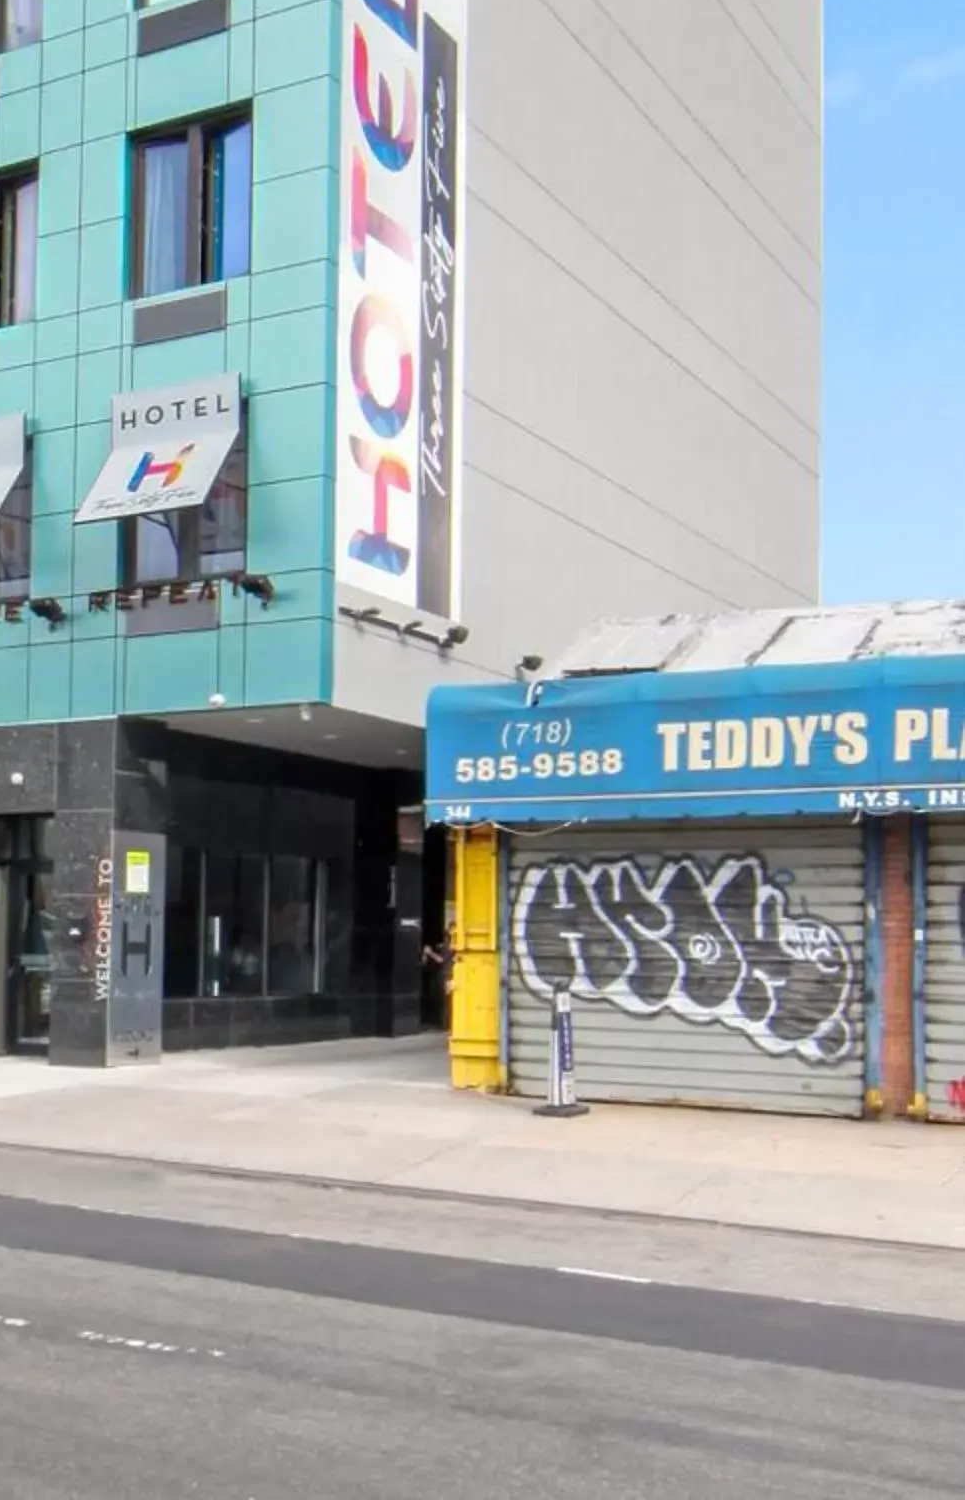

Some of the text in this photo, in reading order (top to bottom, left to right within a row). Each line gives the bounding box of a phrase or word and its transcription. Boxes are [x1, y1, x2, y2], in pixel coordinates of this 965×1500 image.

[420, 76, 454, 497] Three Sixty Five
[119, 394, 230, 431] HOTEL
[500, 717, 572, 749] (718)
[657, 707, 965, 772] TEDDY'S PL
[455, 748, 623, 783] 585-9588
[444, 804, 471, 820] 344
[838, 788, 965, 809] N.Y.S. IN
[95, 858, 114, 1002] WELCOME TO
